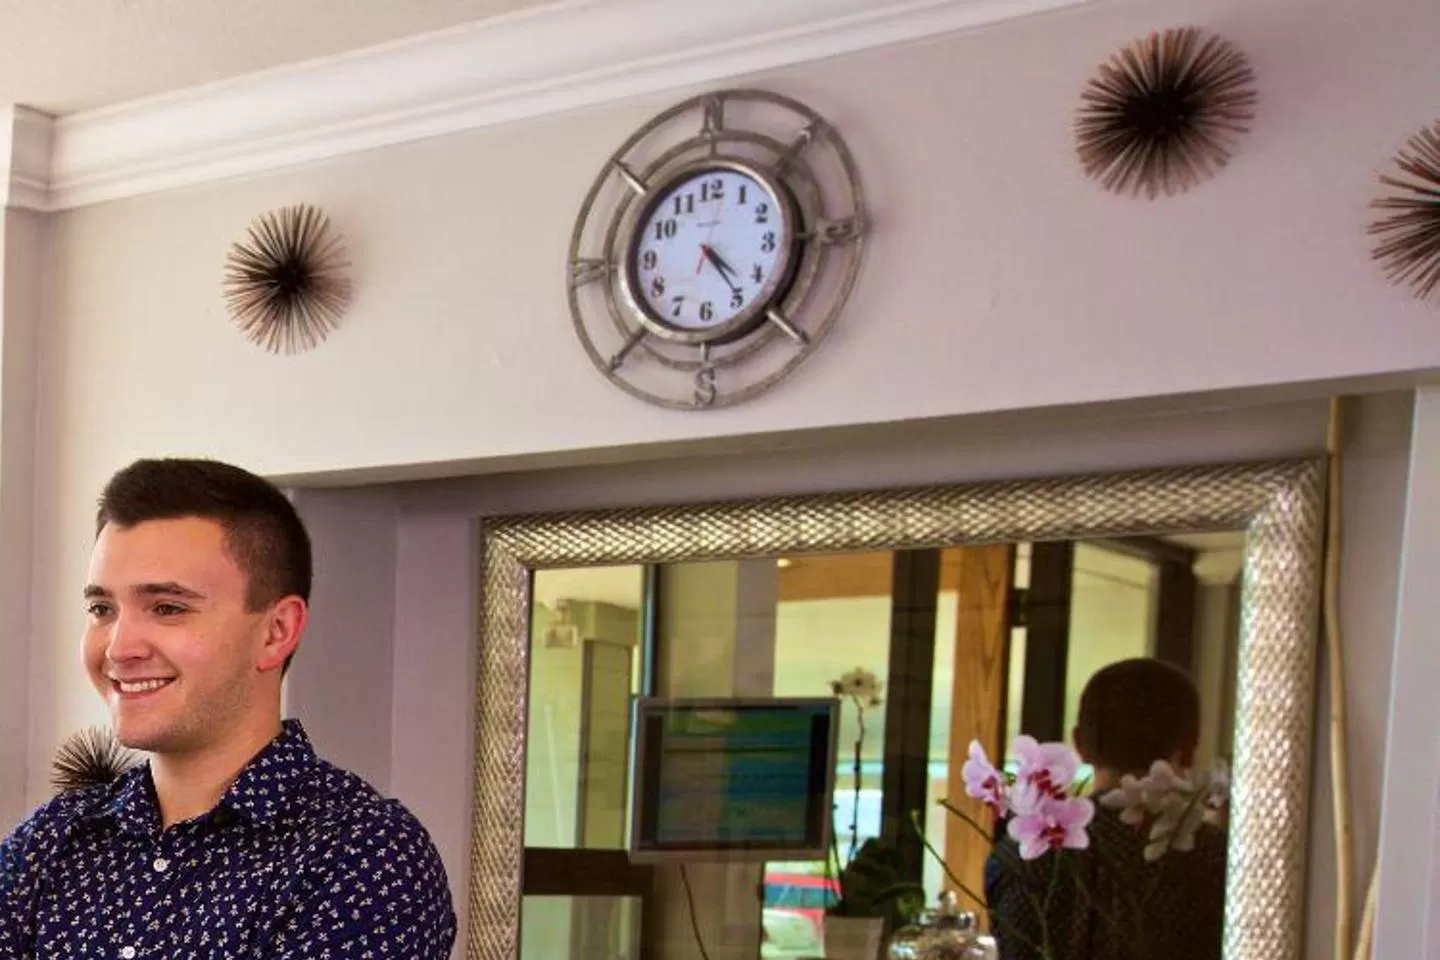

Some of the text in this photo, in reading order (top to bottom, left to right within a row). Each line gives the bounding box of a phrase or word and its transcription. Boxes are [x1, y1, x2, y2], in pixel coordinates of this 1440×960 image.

[699, 179, 724, 203] 12
[738, 184, 747, 205] 1
[674, 193, 694, 215] 11
[755, 203, 768, 224] 2
[655, 218, 677, 241] 10
[760, 232, 776, 253] 3
[643, 250, 658, 271] 9
[750, 263, 764, 284] 4
[651, 276, 665, 298] 8
[672, 295, 685, 317] 7
[730, 287, 744, 309] 5
[699, 301, 713, 322] 6
